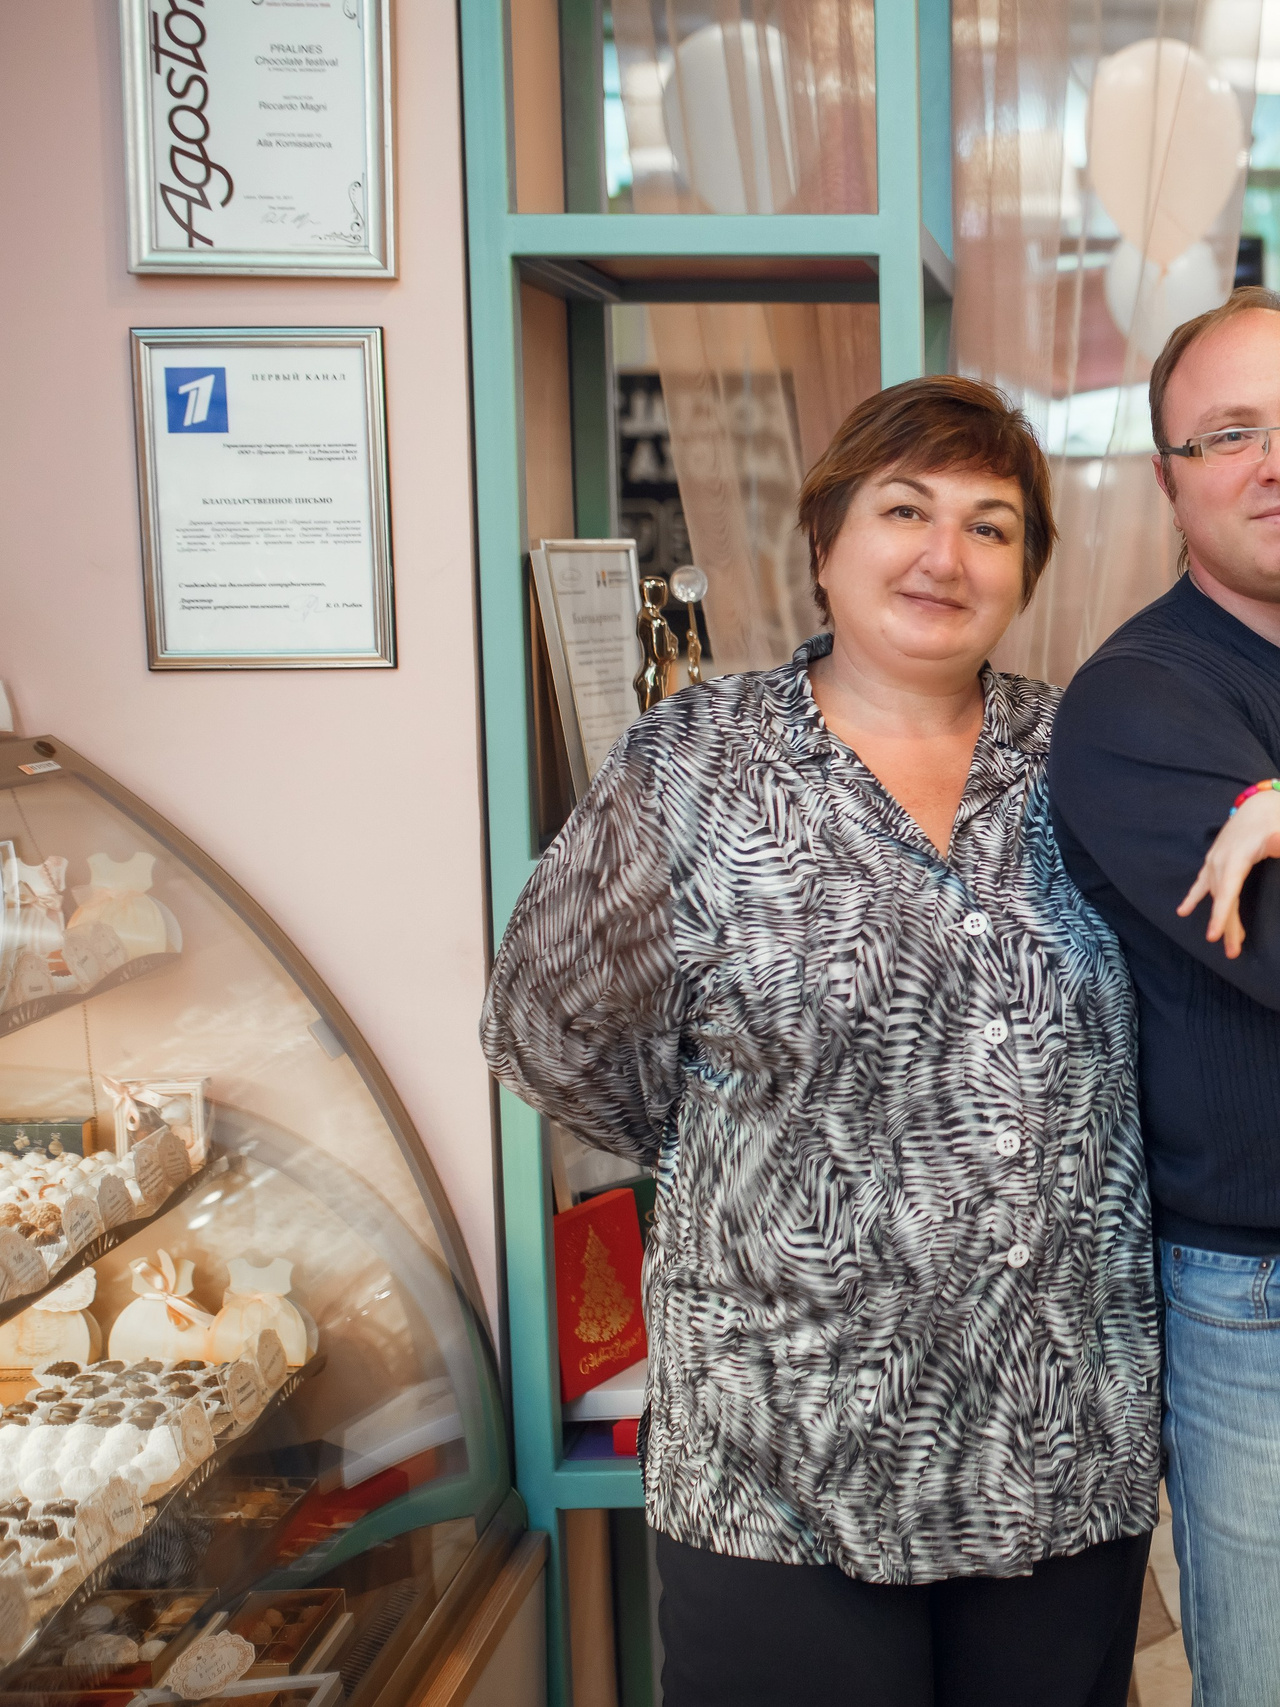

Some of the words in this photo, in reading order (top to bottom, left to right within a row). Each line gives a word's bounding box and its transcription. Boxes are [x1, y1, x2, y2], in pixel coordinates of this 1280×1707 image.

[269, 43, 323, 54] PRALINES
[254, 55, 303, 66] Chocolate
[251, 372, 300, 381] ПЕРВЫЙ
[305, 373, 346, 381] КАНАЛ
[294, 497, 333, 505] ПИСЬМО
